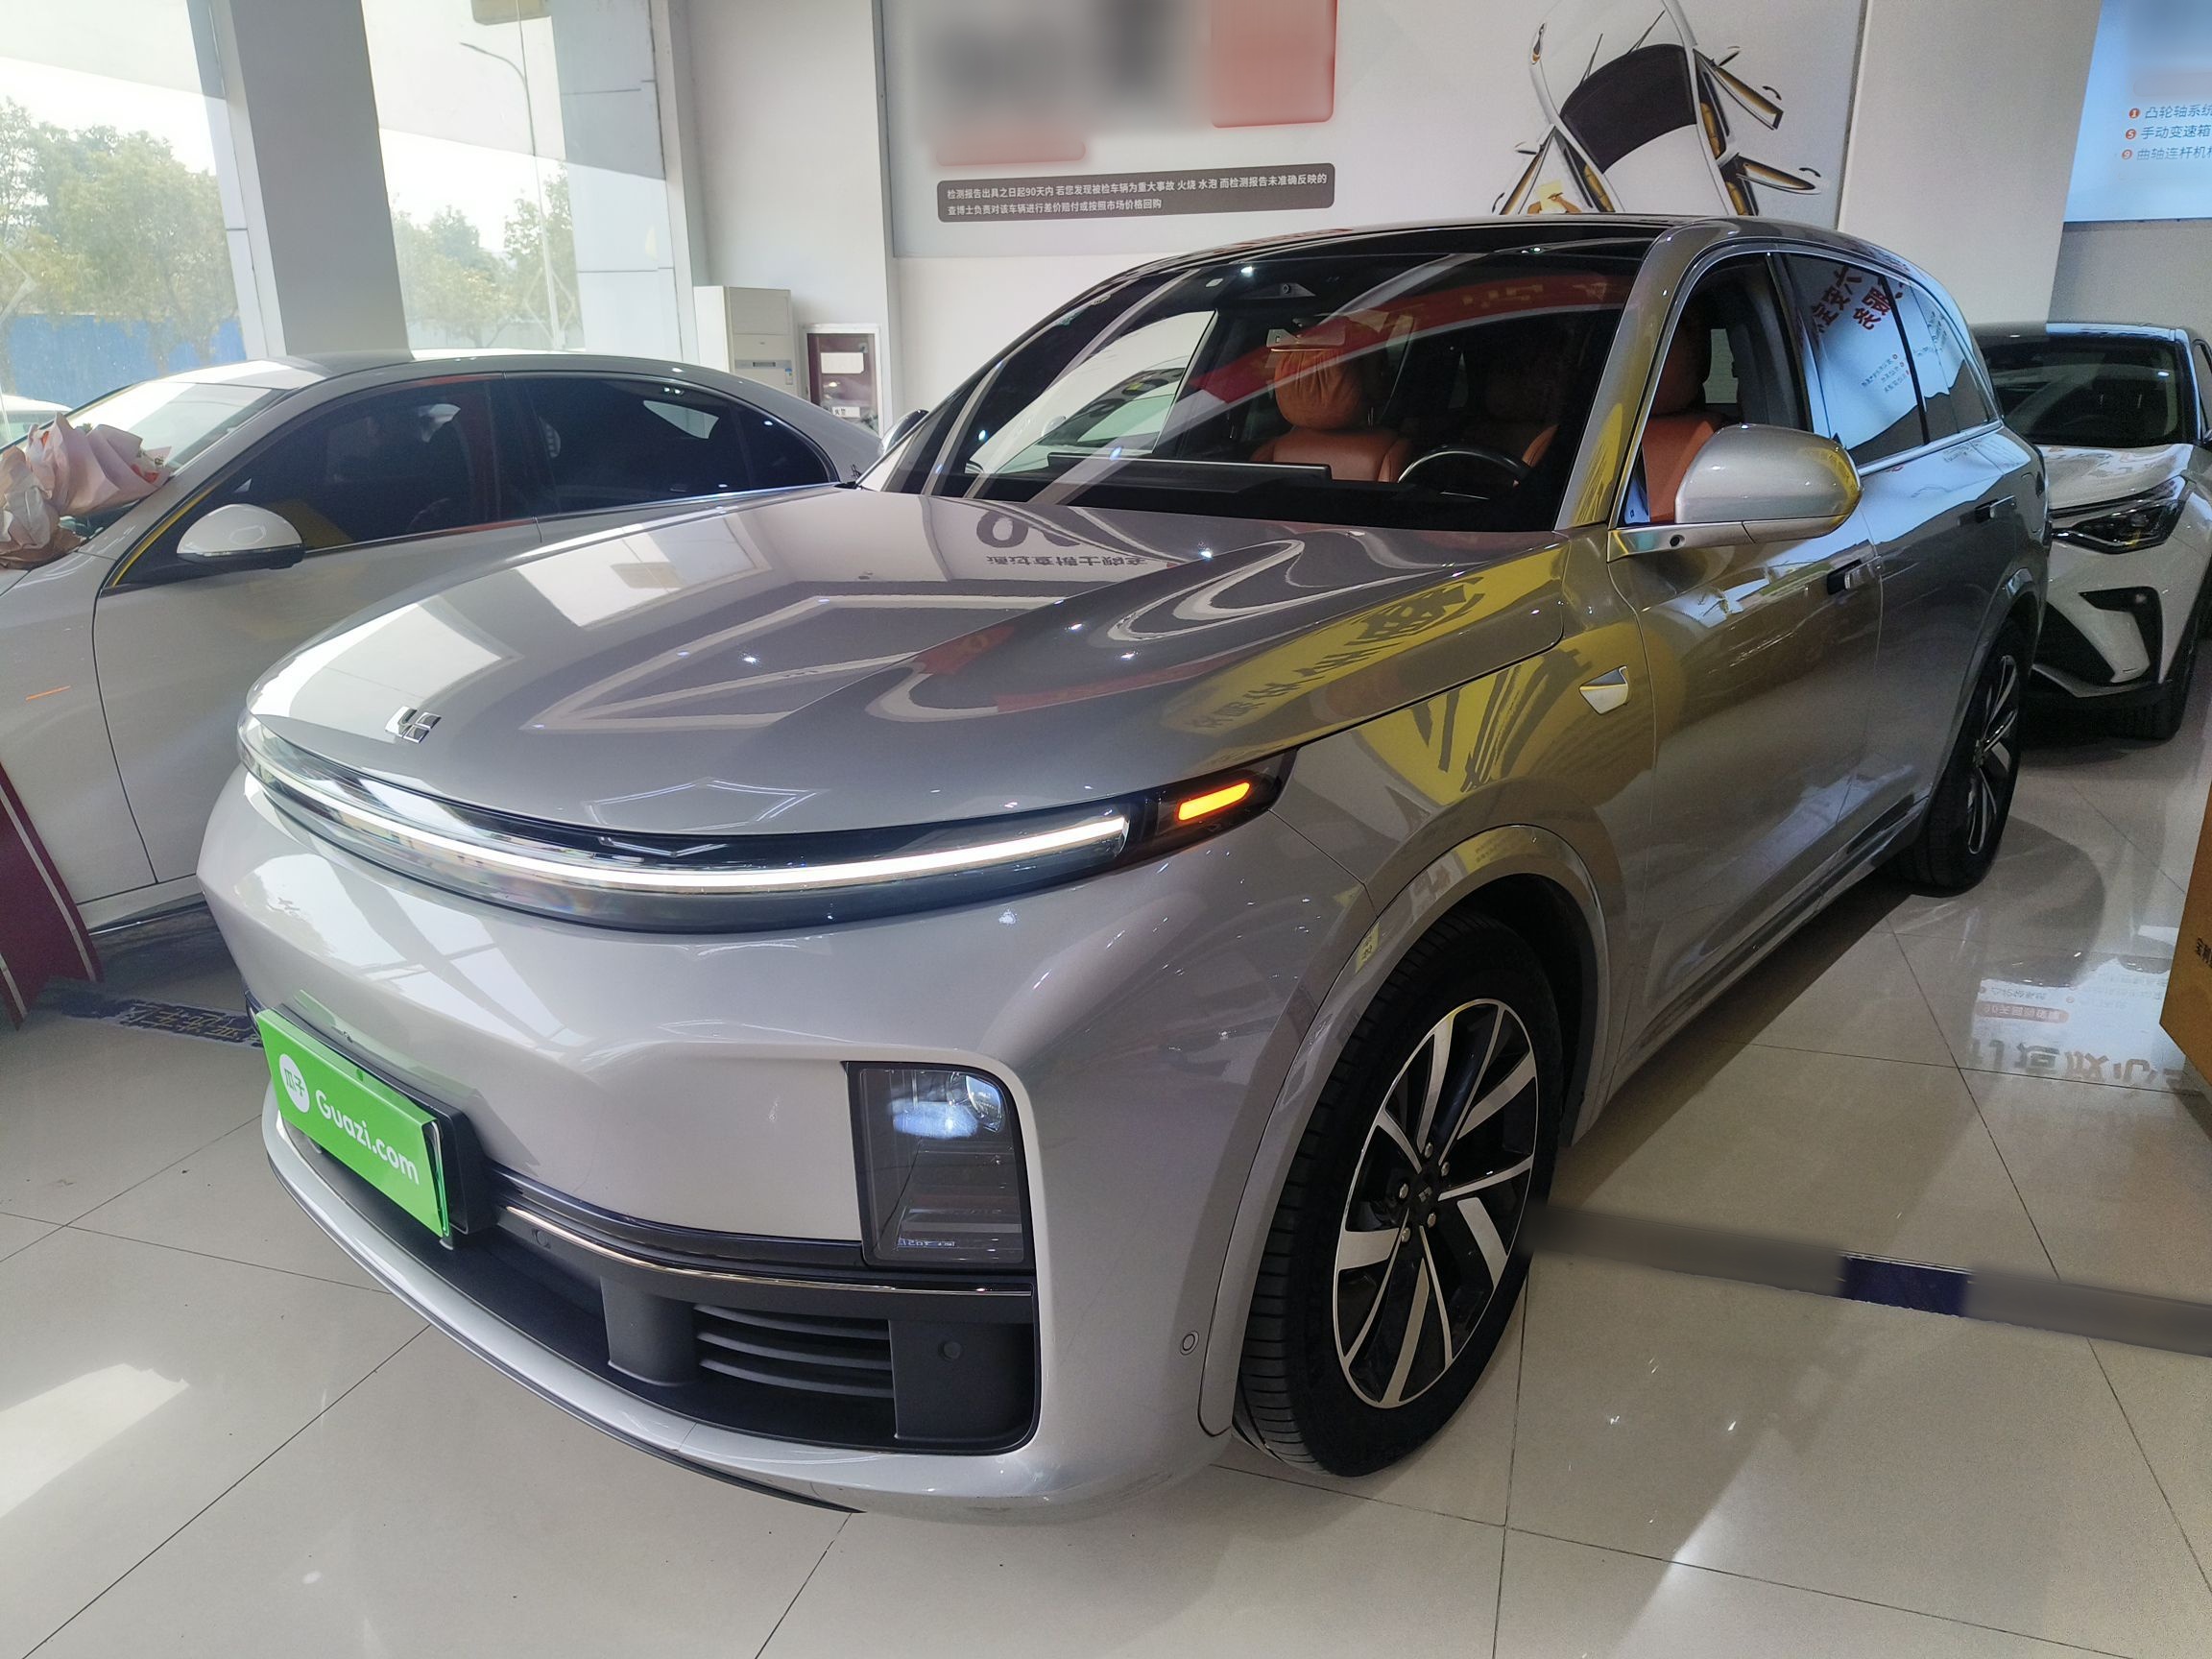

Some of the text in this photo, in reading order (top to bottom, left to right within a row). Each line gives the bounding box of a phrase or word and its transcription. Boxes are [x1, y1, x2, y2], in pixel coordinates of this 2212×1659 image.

[2141, 124, 2211, 139] 手动变速箱
[315, 1089, 420, 1186] Guazi.com
